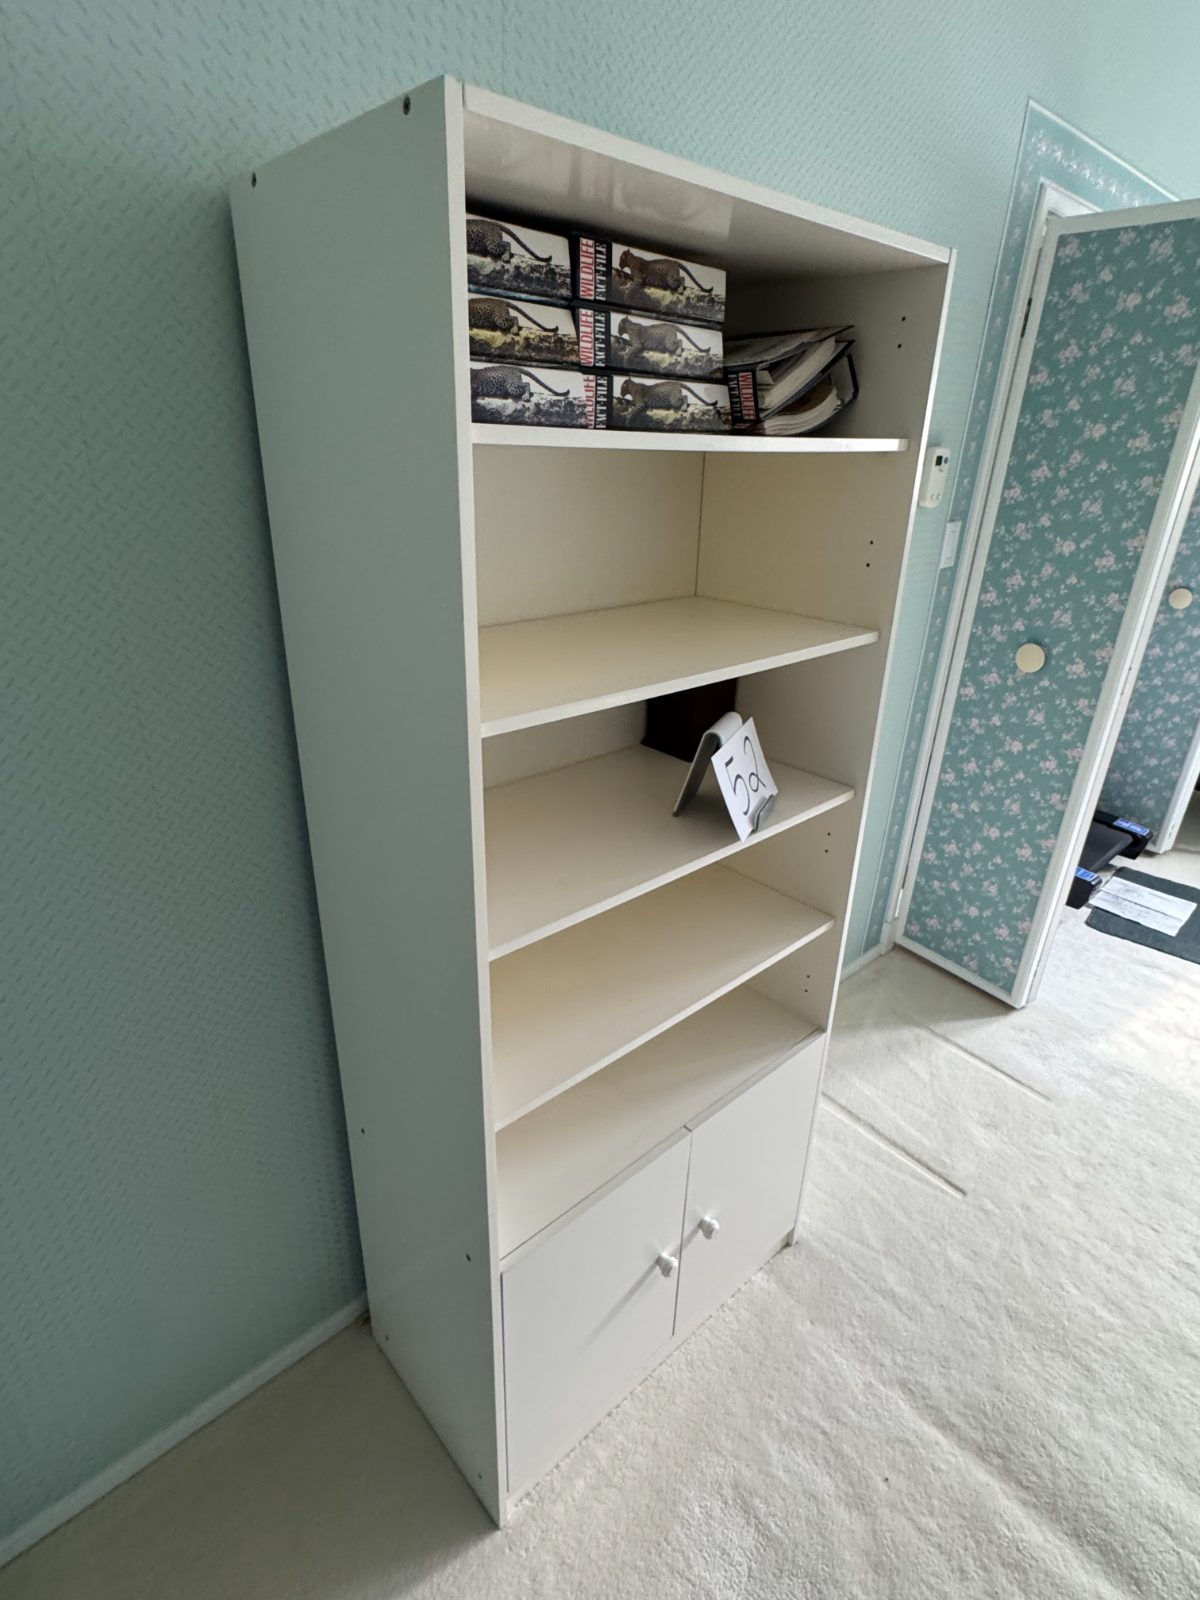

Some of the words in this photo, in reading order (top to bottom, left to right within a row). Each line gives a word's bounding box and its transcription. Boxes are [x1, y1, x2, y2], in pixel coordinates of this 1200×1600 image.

[580, 238, 595, 298] WILDLIFE
[580, 310, 594, 367] WILDLIFE
[739, 372, 756, 420] WILDLIFE
[725, 735, 767, 816] 52
